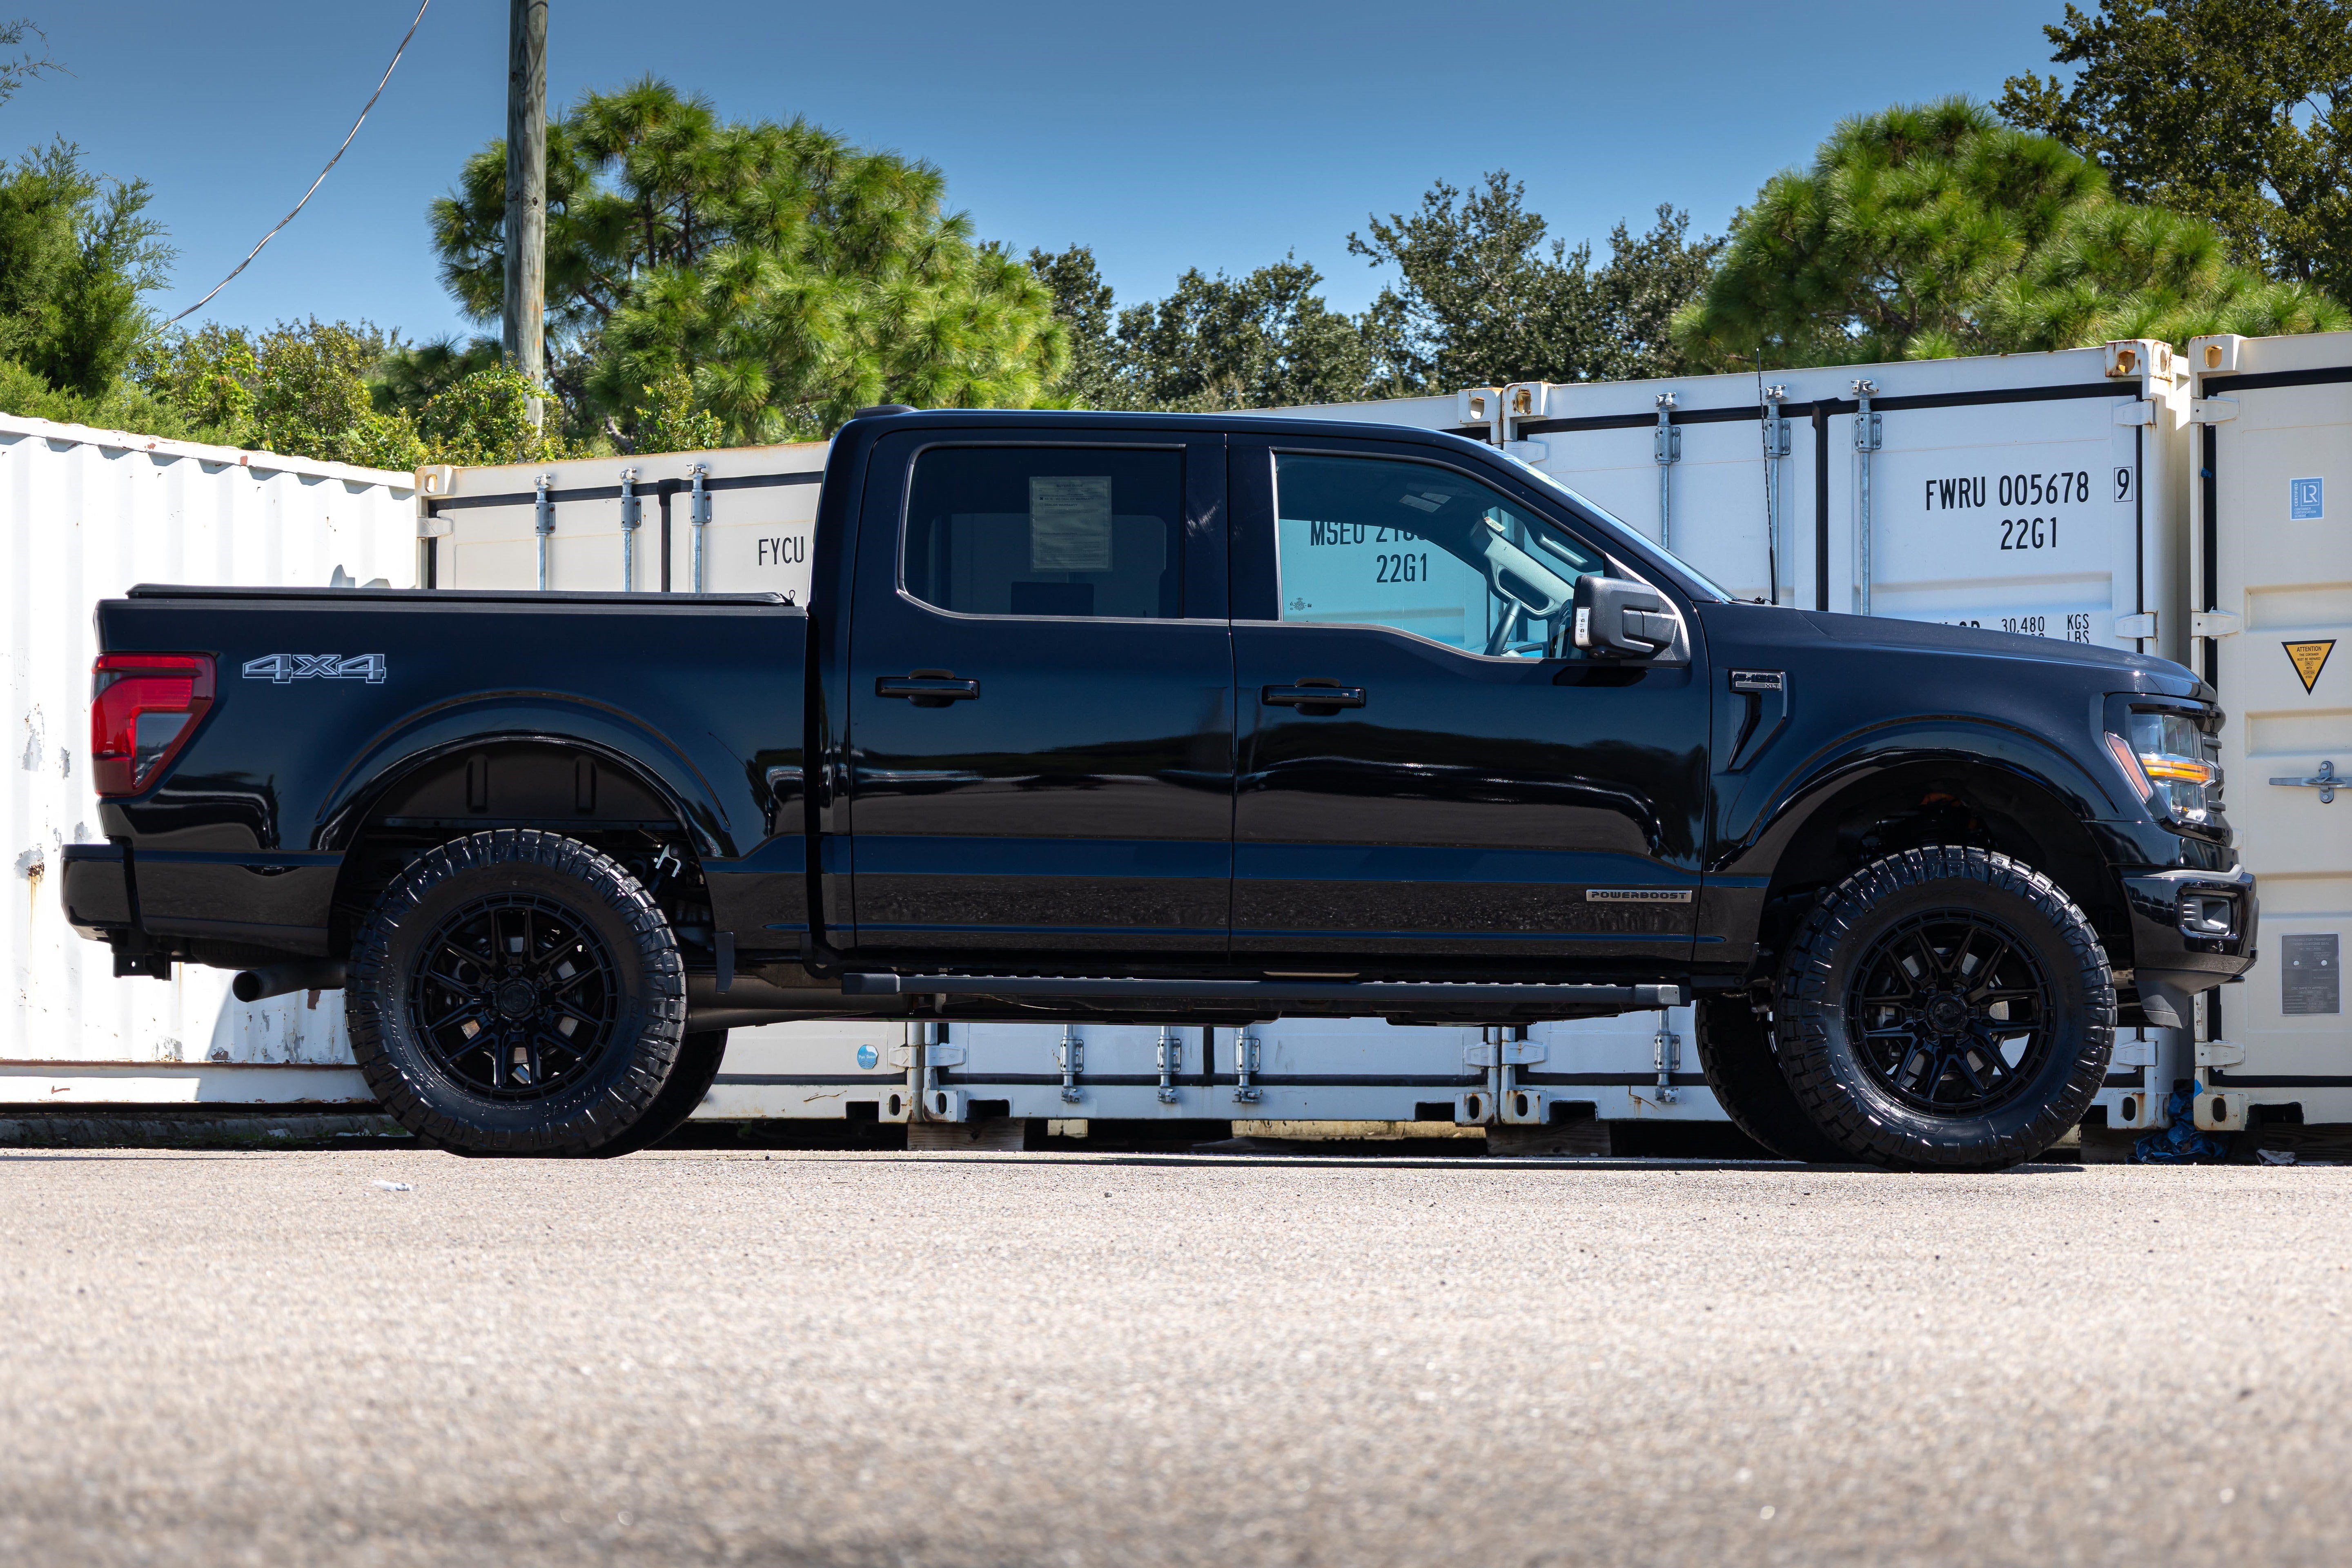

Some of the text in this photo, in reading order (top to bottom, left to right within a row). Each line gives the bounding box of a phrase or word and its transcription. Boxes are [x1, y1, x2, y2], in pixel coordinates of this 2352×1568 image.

[1926, 468, 2130, 510] FWRU 005678 9
[2000, 517, 2057, 550] 22G1
[758, 536, 804, 566] FYCU
[1376, 552, 1427, 583] 22G1
[2001, 616, 2045, 633] 30,480
[2067, 613, 2089, 630] KGS
[1591, 891, 1687, 899] POWERBOOST
